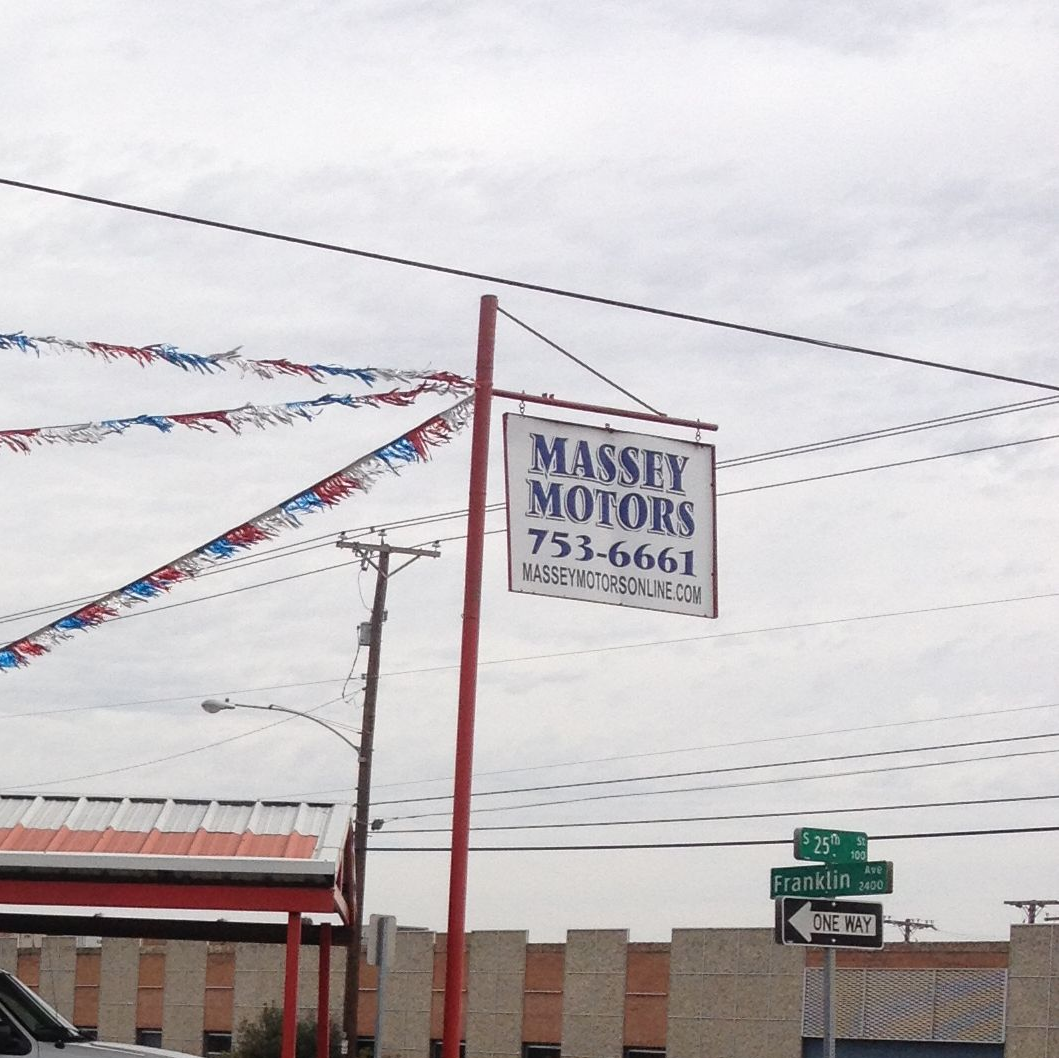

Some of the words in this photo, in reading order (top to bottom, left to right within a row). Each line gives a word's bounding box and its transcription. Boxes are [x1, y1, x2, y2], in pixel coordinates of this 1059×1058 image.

[528, 432, 690, 496] MASSEY
[525, 478, 695, 539] MOTORS
[528, 528, 697, 578] 753-6661
[522, 562, 702, 605] MASSEYMOTORSONLINE.COM
[803, 832, 810, 845] S
[850, 850, 866, 860] 100
[774, 870, 850, 893] Franklin
[864, 865, 883, 874] Ave
[859, 880, 884, 891] 2400
[813, 913, 839, 932] ONE
[845, 915, 872, 933] WAY
